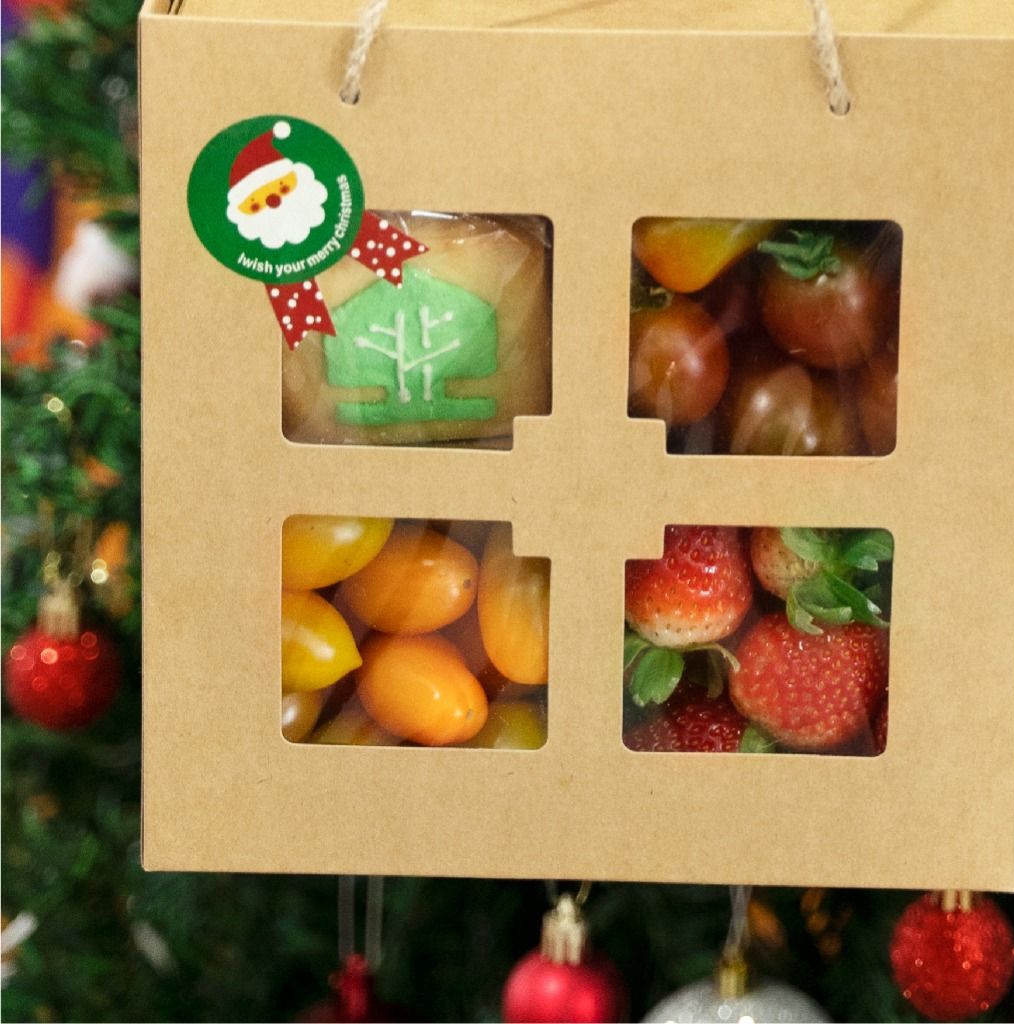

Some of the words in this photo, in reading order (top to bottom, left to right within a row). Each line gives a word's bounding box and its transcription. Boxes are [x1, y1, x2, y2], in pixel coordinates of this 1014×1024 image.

[275, 260, 306, 278] your
[306, 236, 341, 268] merry
[334, 174, 352, 238] christmas
